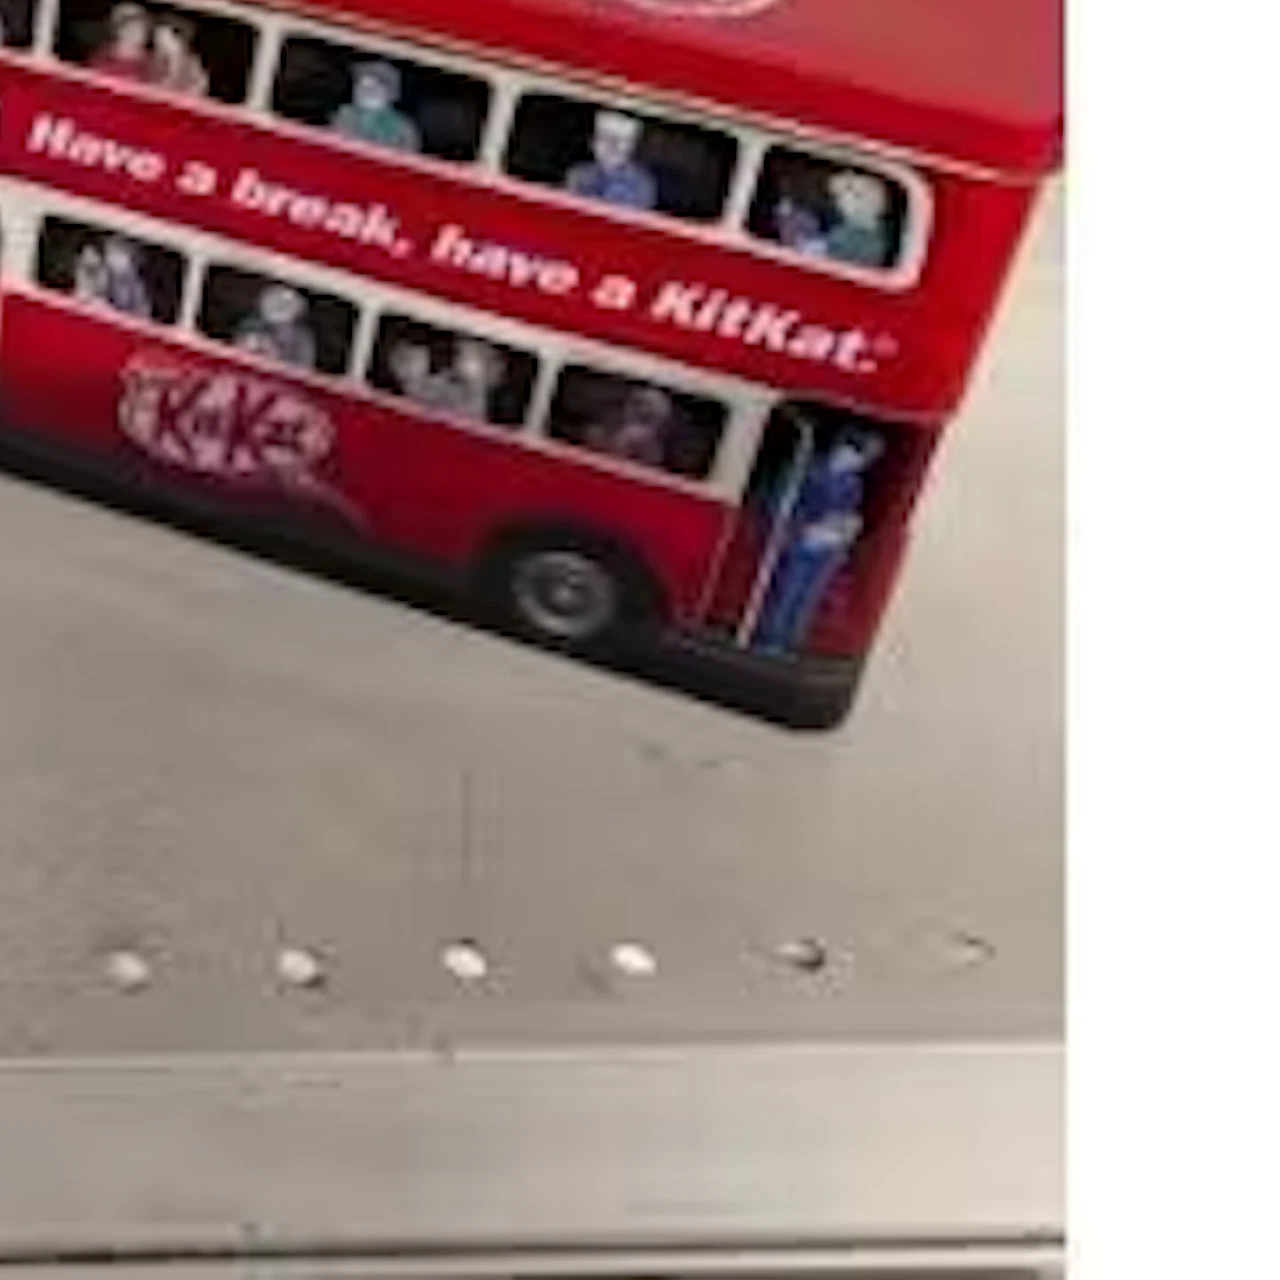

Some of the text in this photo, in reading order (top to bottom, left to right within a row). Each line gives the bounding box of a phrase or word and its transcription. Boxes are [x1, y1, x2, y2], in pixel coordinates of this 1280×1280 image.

[26, 113, 167, 182] Have
[174, 160, 217, 196] a
[231, 167, 414, 260] break,
[431, 223, 581, 295] have
[593, 274, 637, 310] a
